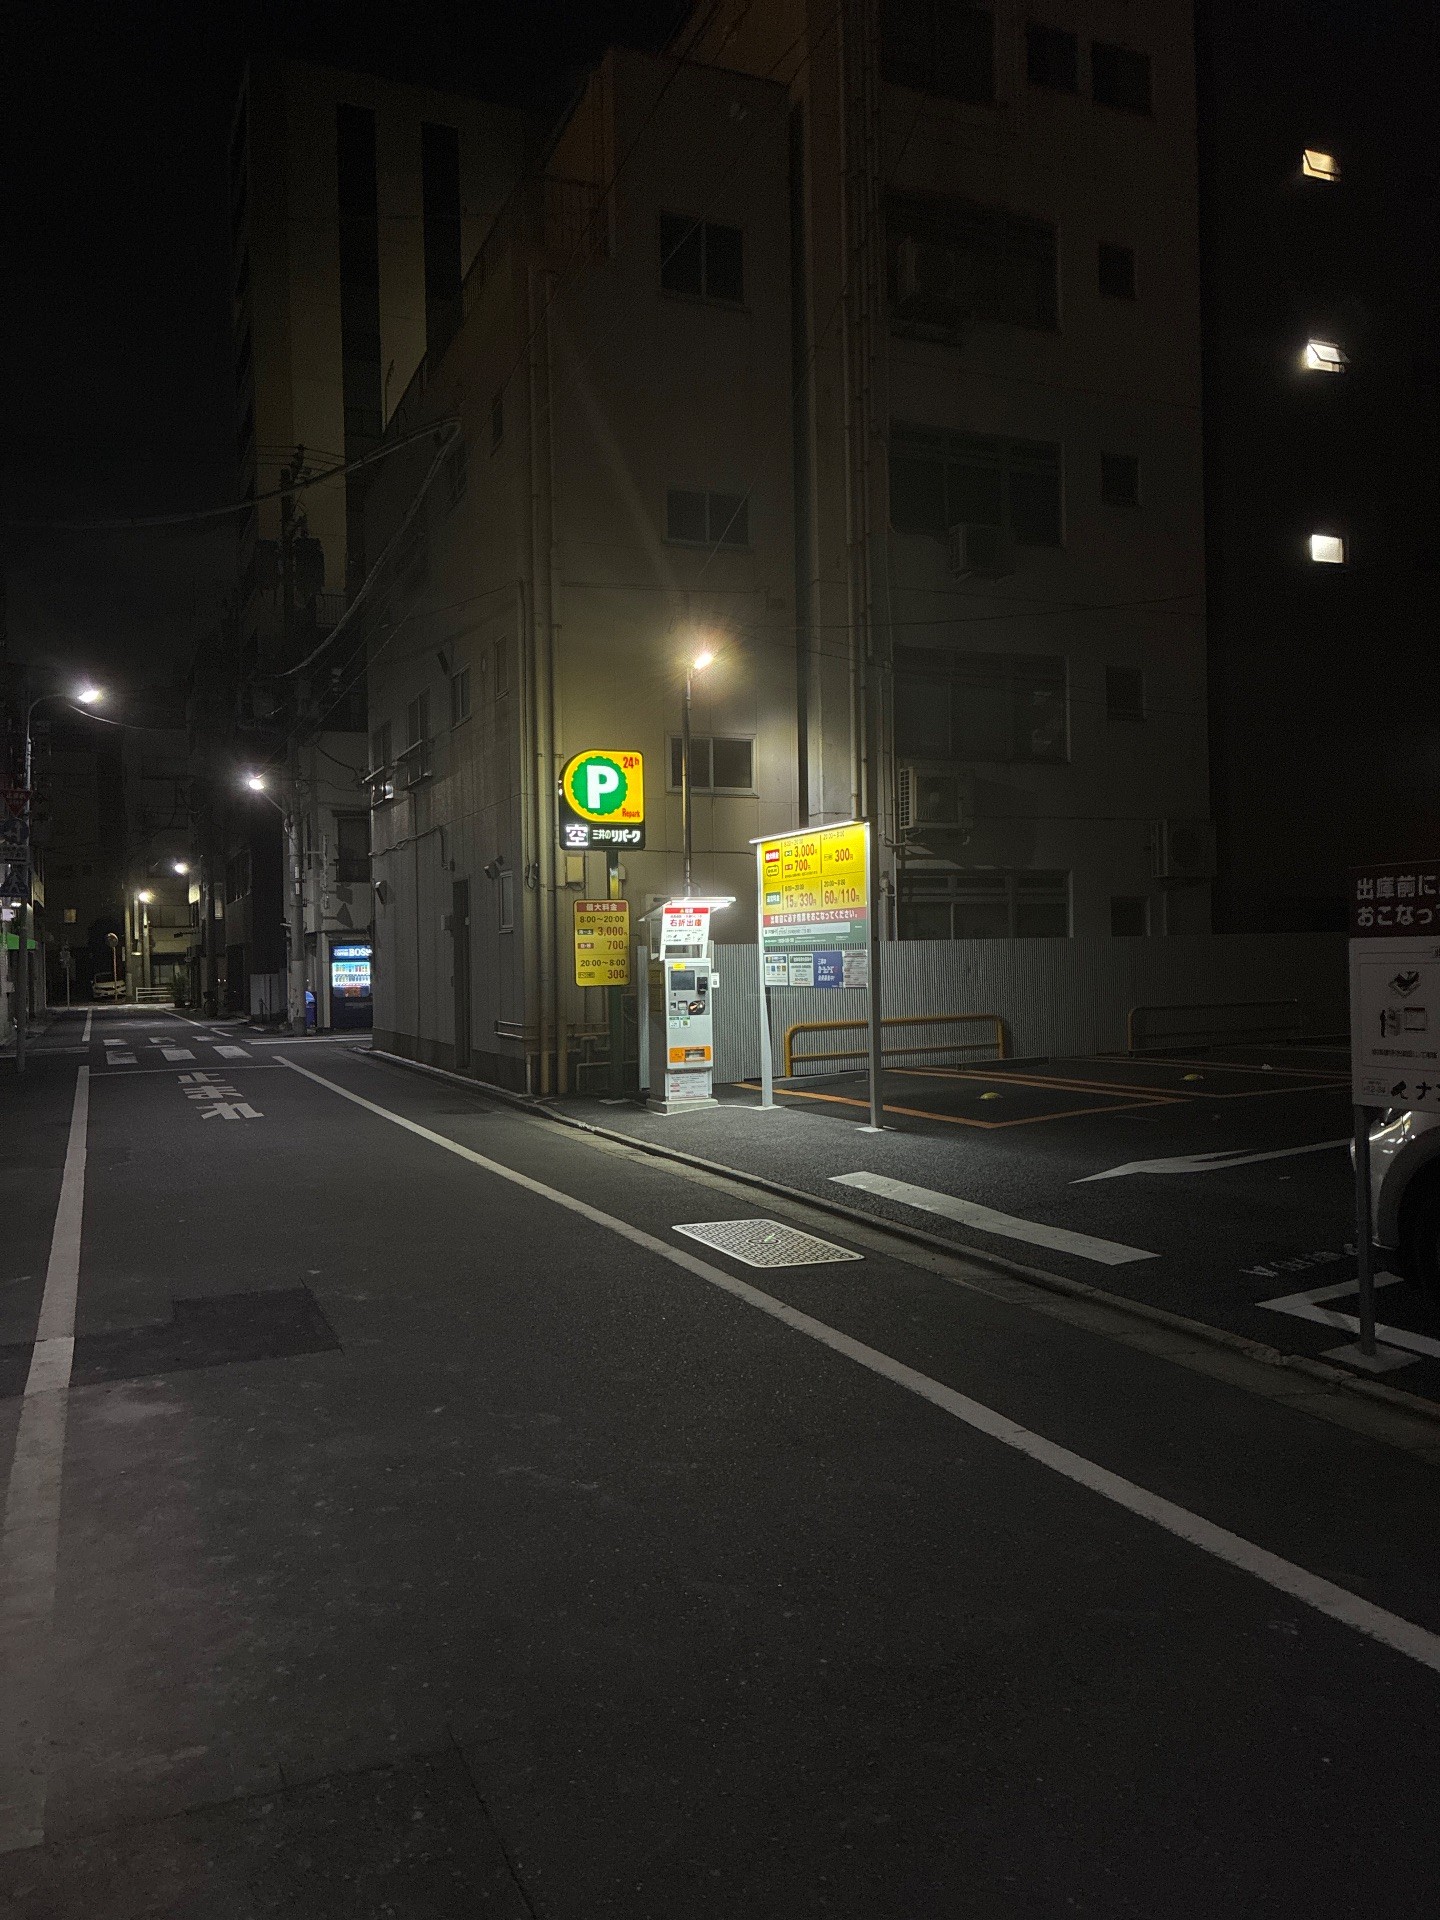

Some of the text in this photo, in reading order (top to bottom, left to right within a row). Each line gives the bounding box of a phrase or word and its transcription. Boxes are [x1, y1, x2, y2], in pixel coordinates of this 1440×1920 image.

[586, 764, 619, 809] P
[622, 808, 641, 818] Repark
[565, 824, 589, 846] 空
[592, 829, 641, 843] 三井のリパーク
[1356, 875, 1440, 900] 出庫前に
[1357, 904, 1440, 927] おこなっ
[177, 1071, 265, 1120] 止まれ
